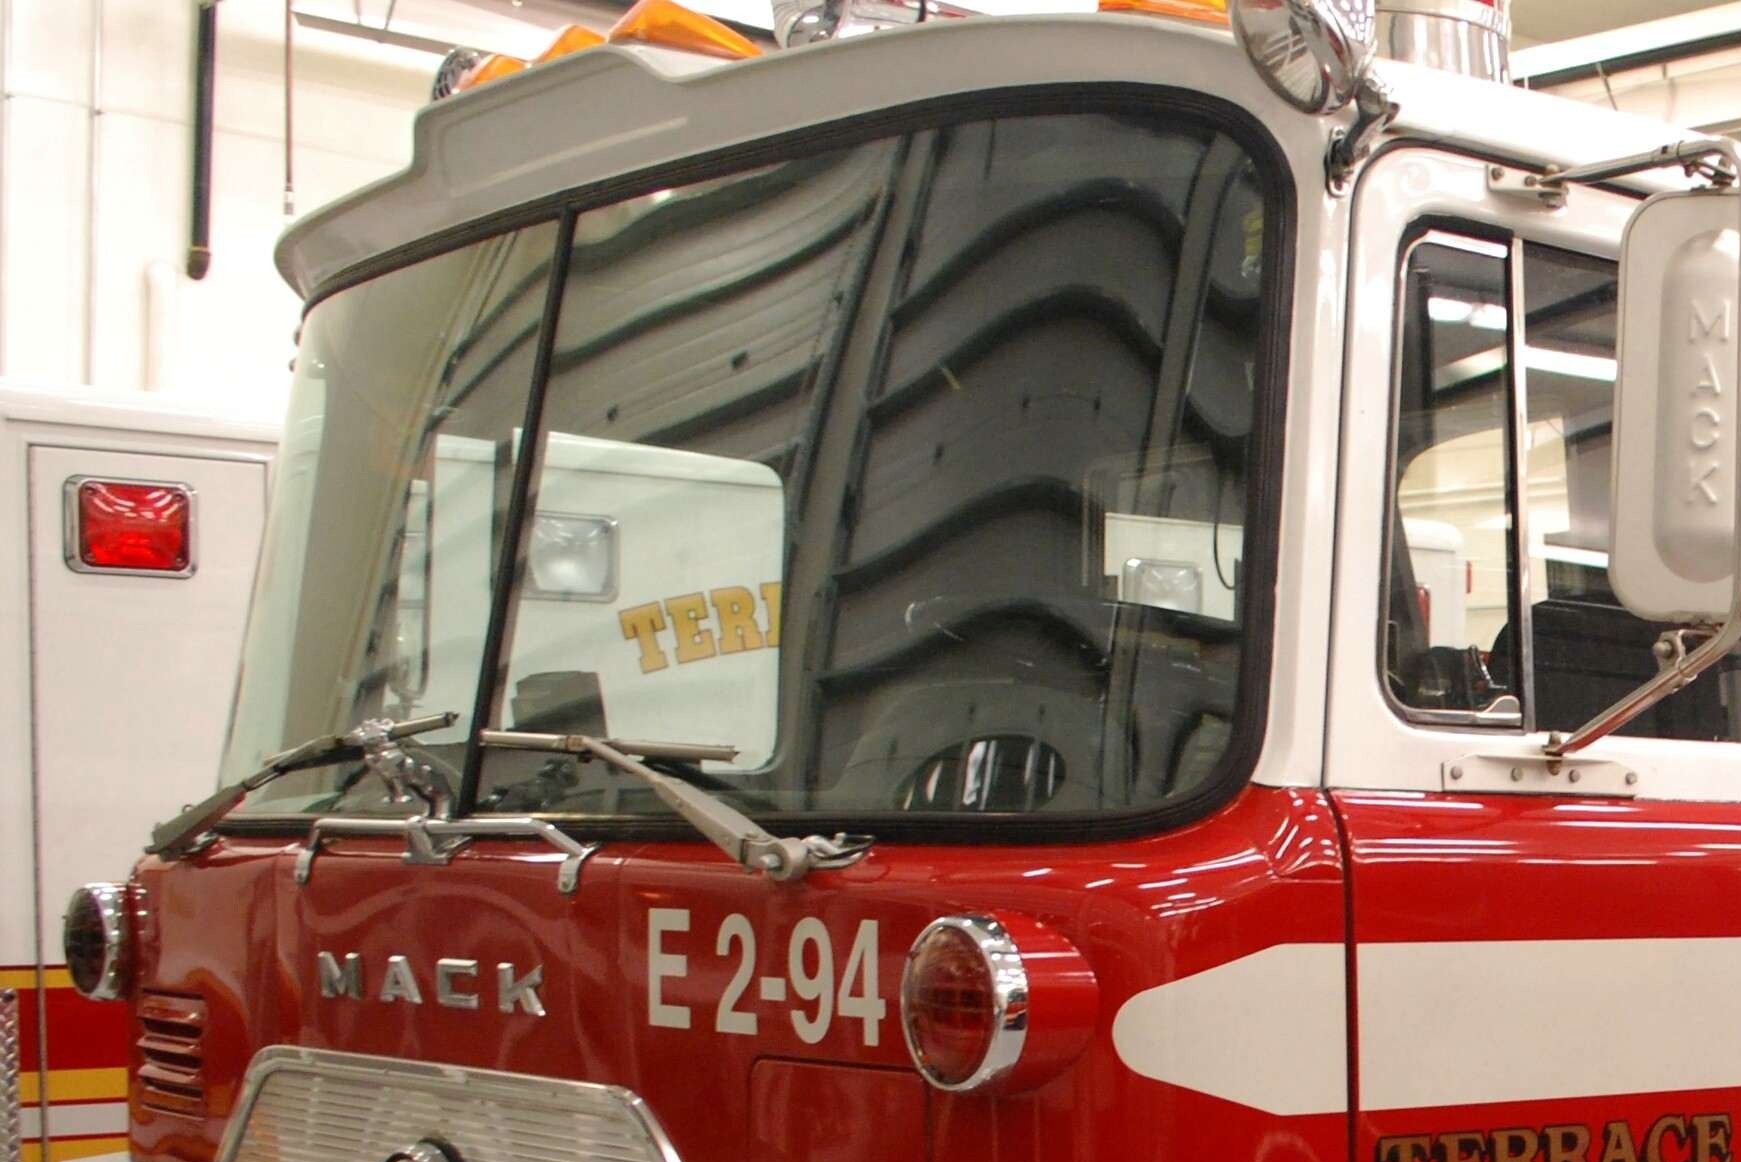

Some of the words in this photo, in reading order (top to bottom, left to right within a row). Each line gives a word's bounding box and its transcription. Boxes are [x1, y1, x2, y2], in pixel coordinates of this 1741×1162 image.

[1685, 298, 1732, 505] MACK
[317, 951, 547, 1017] MACK
[648, 908, 691, 1030] E
[715, 912, 887, 1047] 2-94
